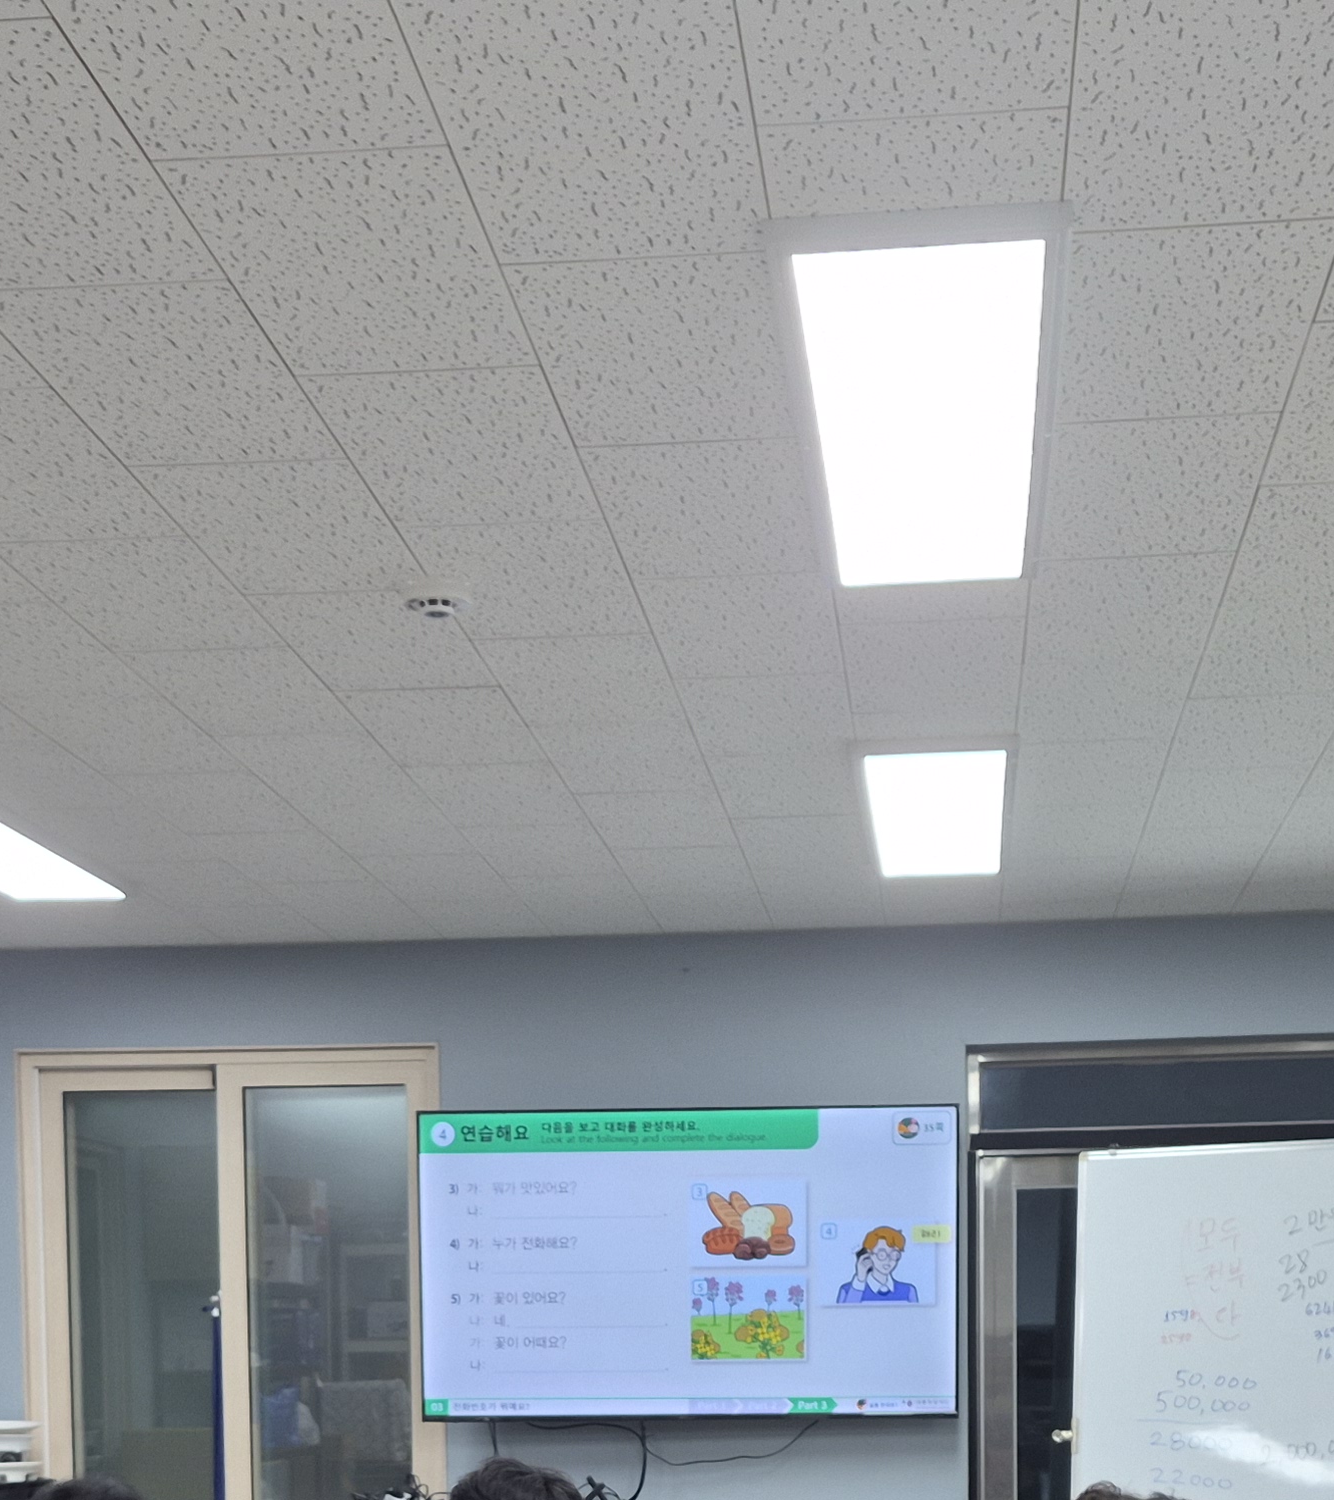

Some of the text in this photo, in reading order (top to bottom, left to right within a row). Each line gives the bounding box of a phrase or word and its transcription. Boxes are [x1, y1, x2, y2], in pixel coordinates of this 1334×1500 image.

[461, 1123, 530, 1144] 연습해요
[541, 1122, 573, 1134] 다음을
[578, 1122, 600, 1134] 보고
[448, 1183, 460, 1195] 3)
[520, 1180, 578, 1195] 맛있어요?
[1196, 1217, 1241, 1254] 모두
[449, 1238, 461, 1251] 4)
[521, 1236, 578, 1250] 전화해요?
[1278, 1247, 1310, 1276] 28
[450, 1293, 461, 1306] 5)
[522, 1291, 566, 1305] 있어요?
[430, 1402, 443, 1412] 03
[798, 1400, 827, 1410] Part 3
